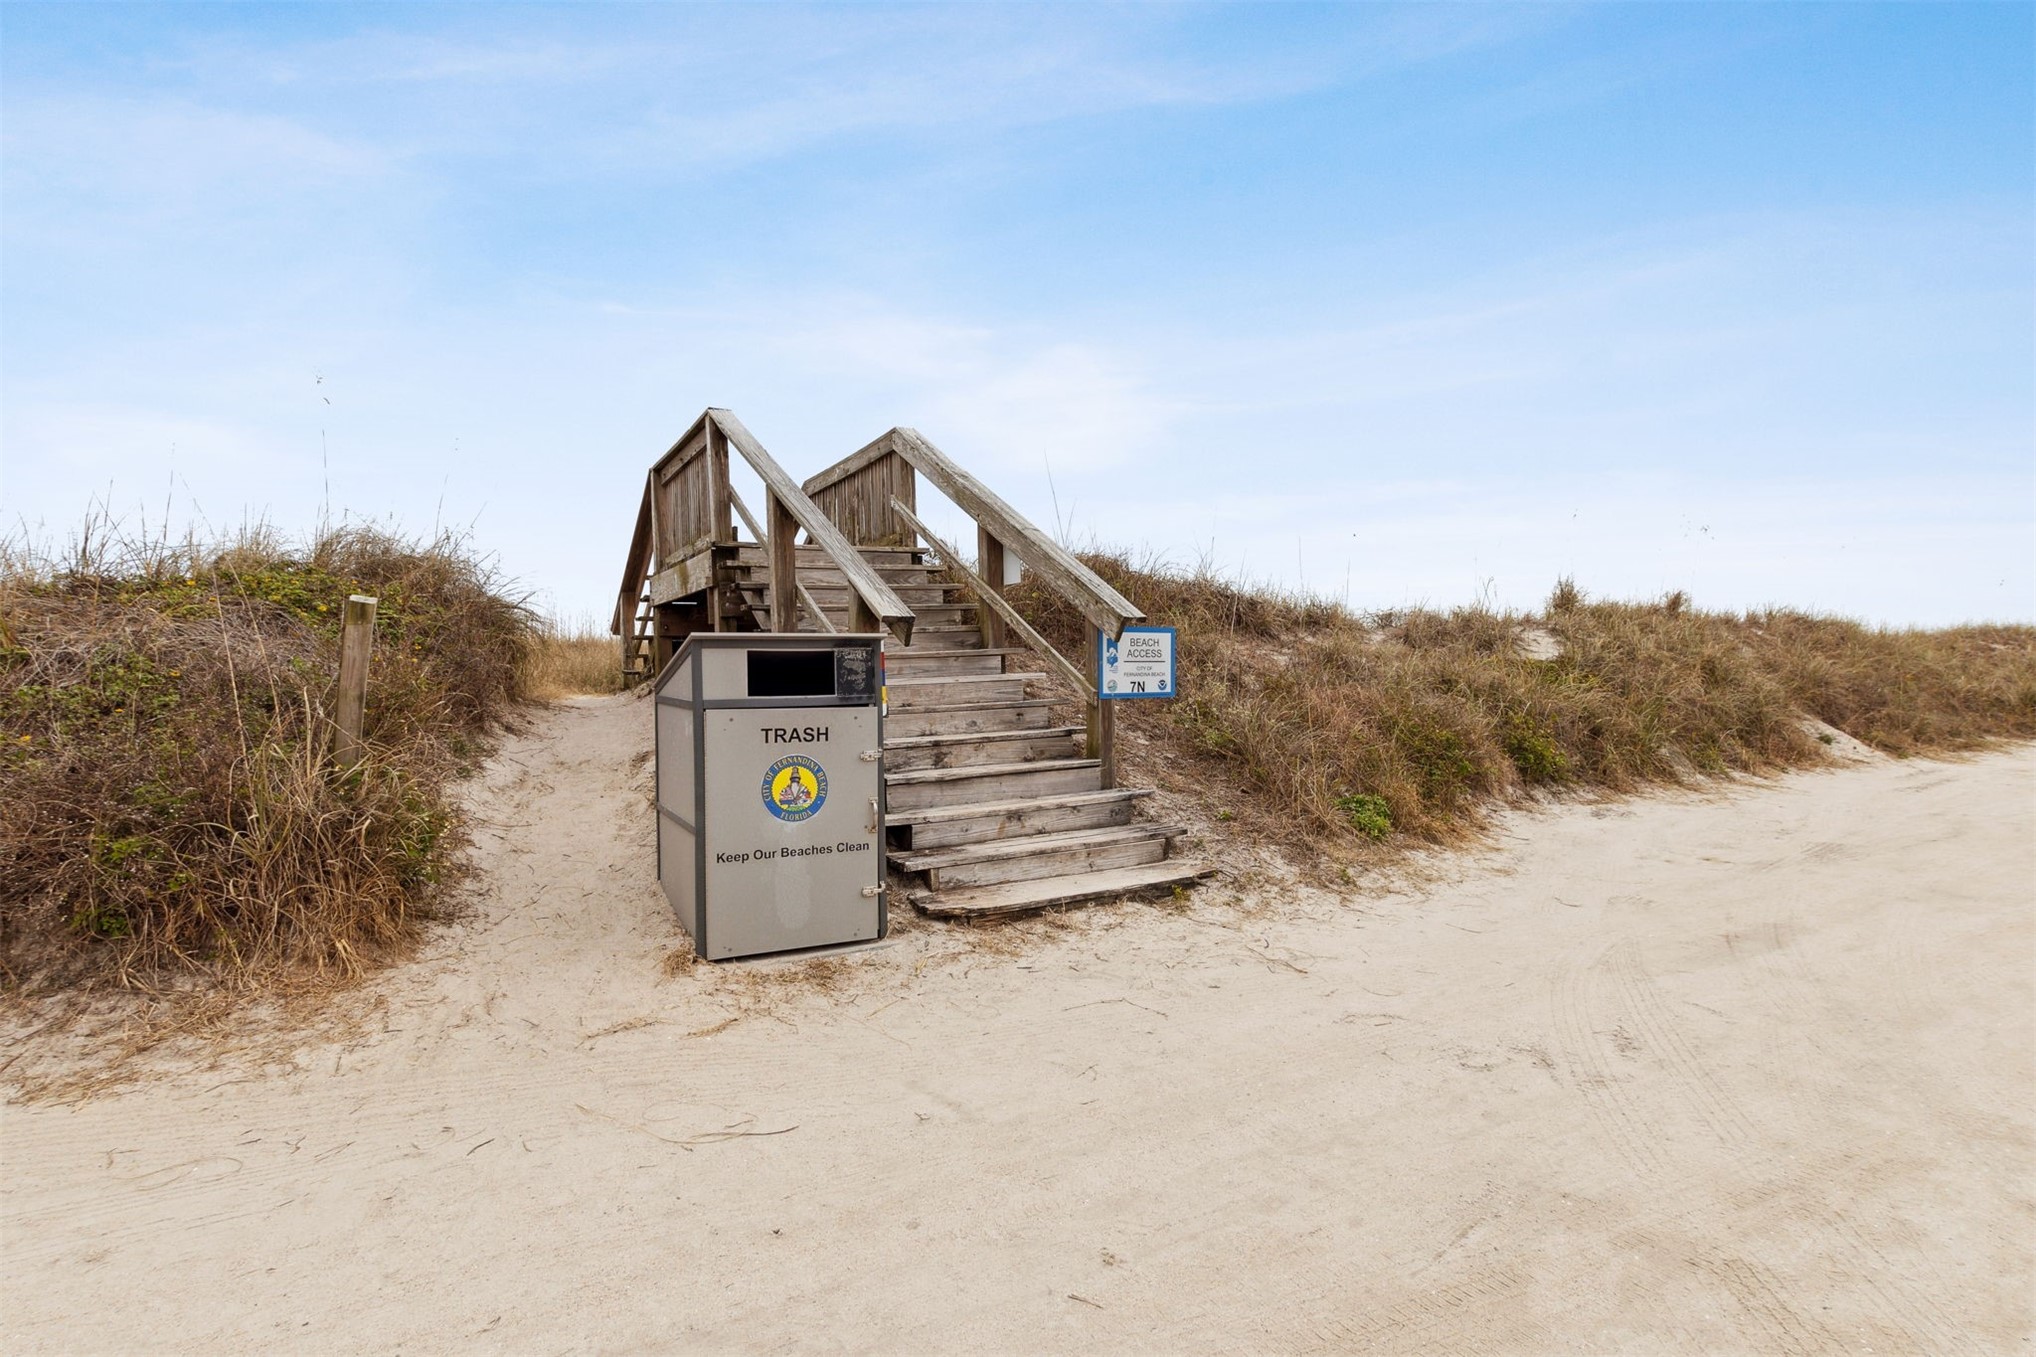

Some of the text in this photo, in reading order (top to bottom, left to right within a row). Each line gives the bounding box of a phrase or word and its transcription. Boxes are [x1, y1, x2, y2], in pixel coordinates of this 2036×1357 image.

[1130, 638, 1159, 647] BEACH
[1127, 649, 1162, 658] ACCESS
[1130, 681, 1145, 692] 7N
[761, 727, 829, 744] TRASH
[766, 770, 774, 780] OF
[773, 756, 819, 771] FERNANDINA
[817, 772, 827, 797] BEACH
[780, 809, 812, 821] FLORIDA
[716, 842, 870, 864] Keep Our Beaches Clean
